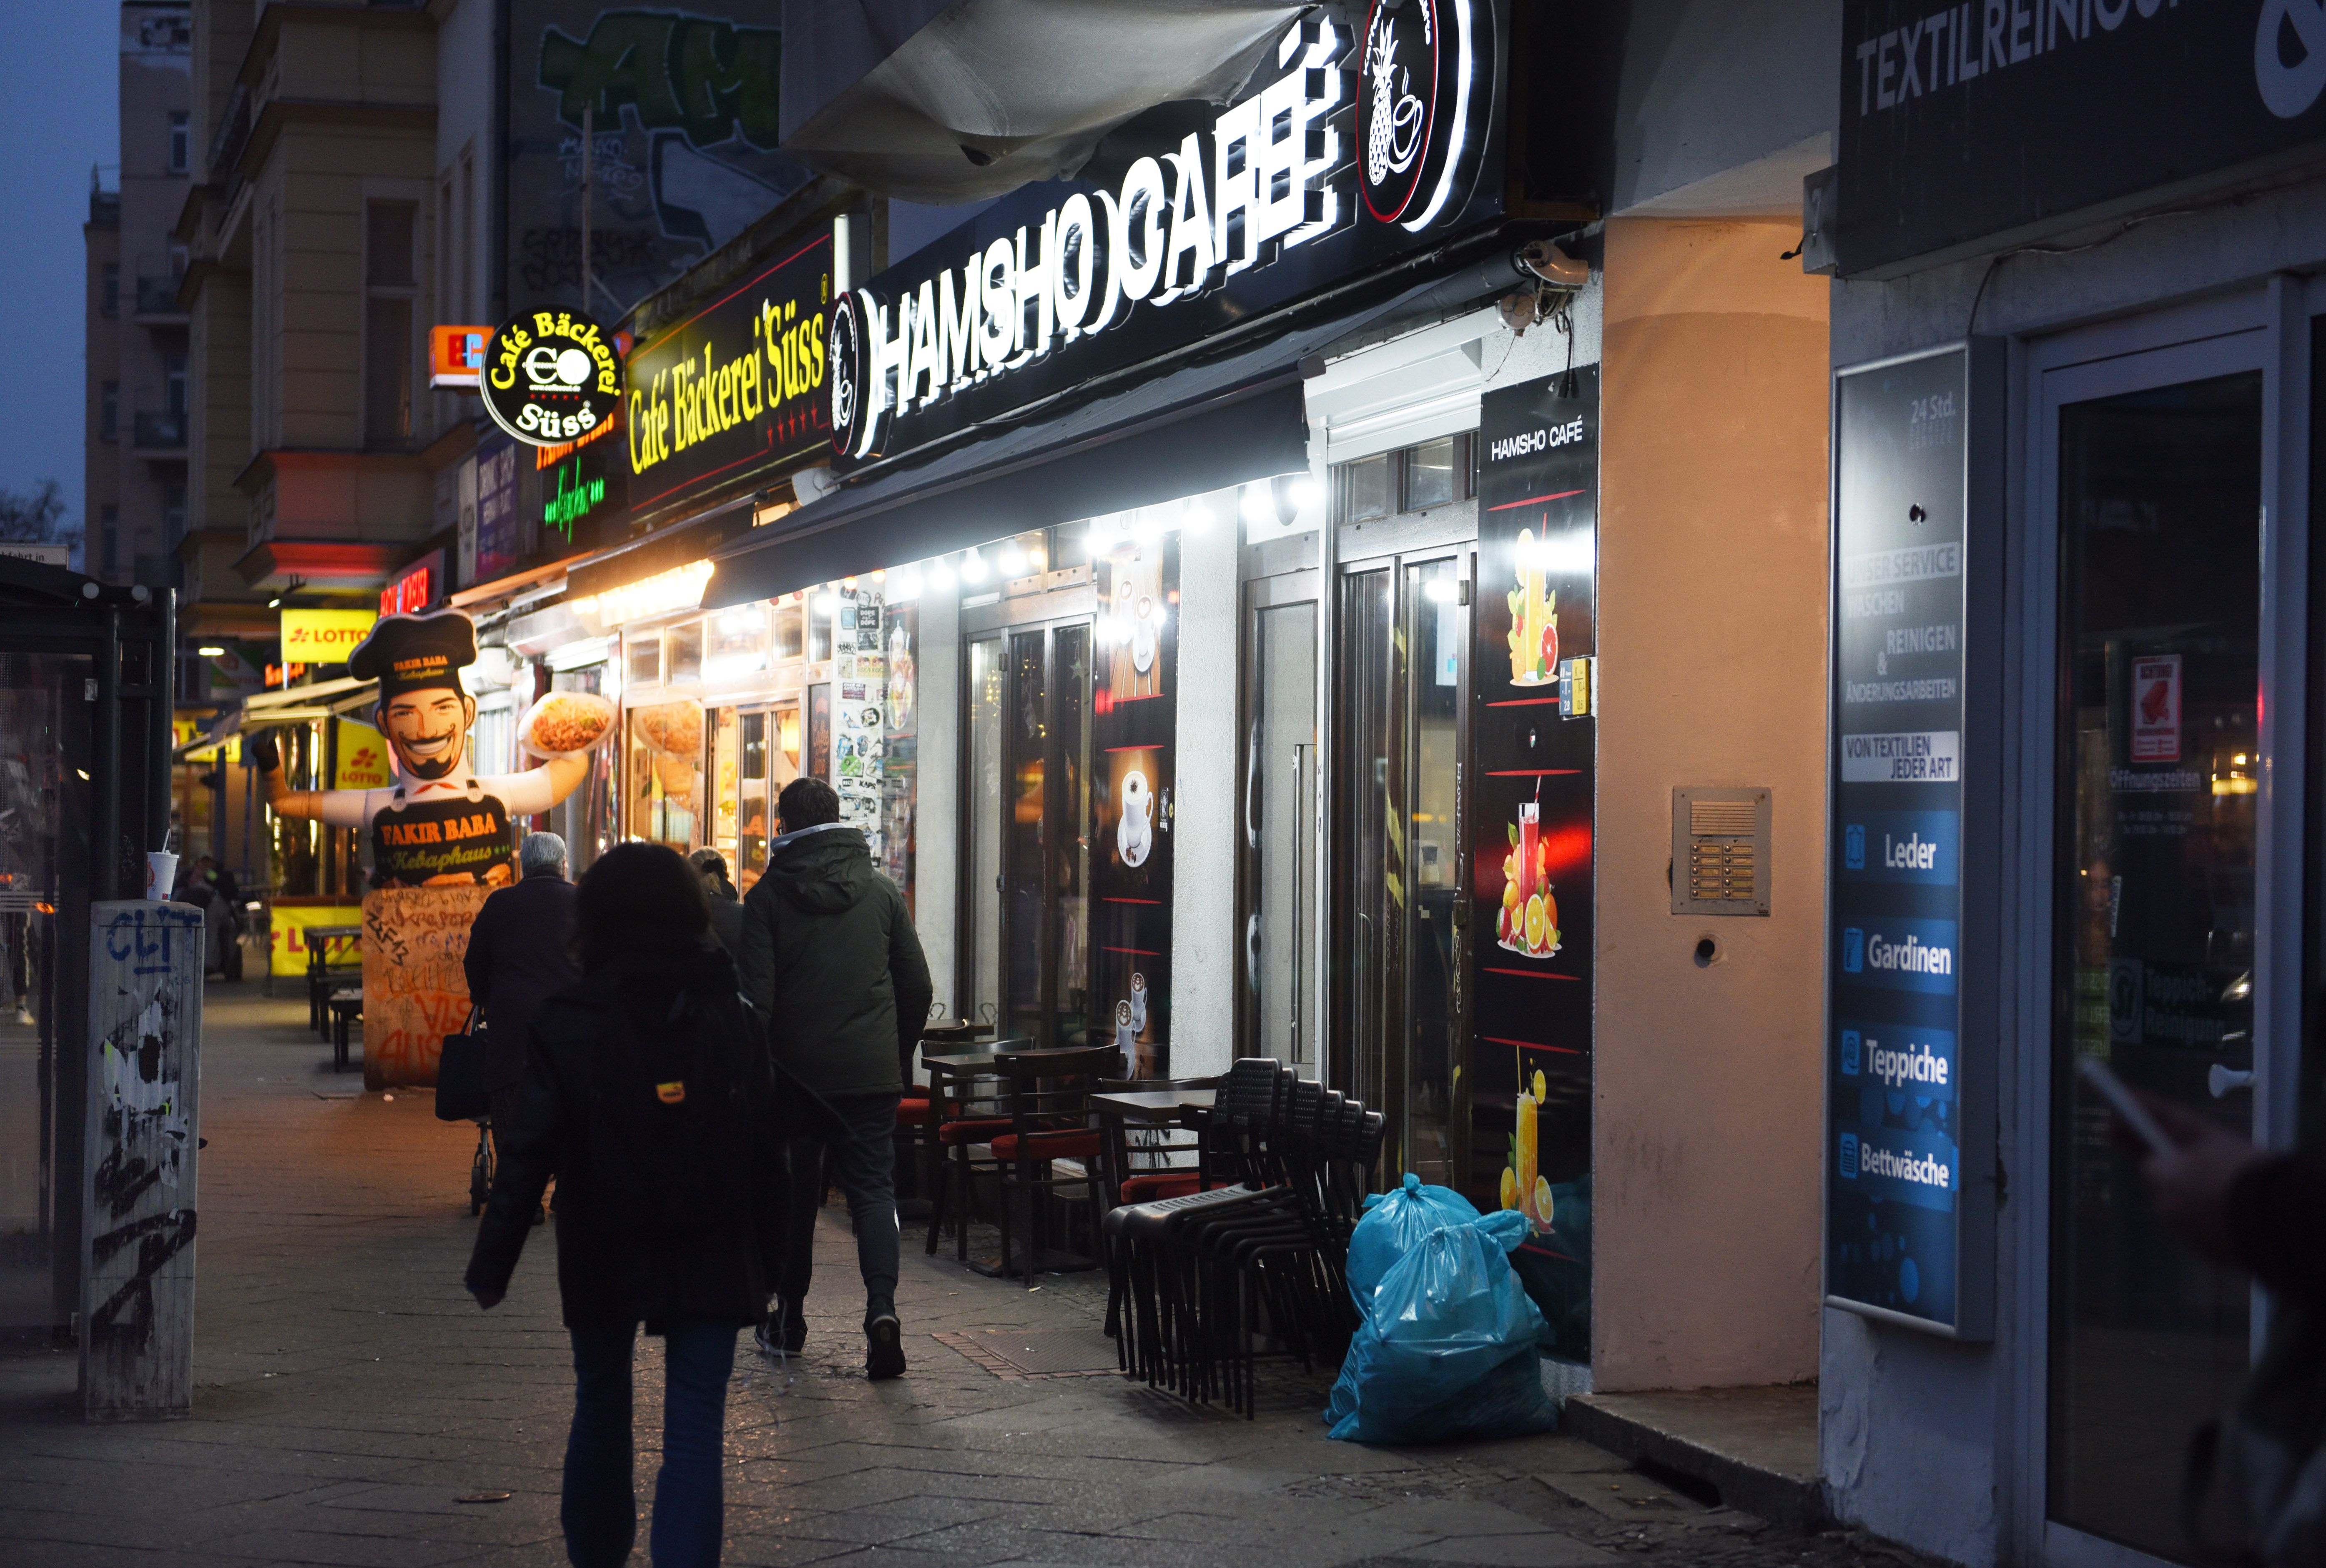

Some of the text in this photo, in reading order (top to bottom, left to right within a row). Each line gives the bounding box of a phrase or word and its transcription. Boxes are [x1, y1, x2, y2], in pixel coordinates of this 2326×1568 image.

[1857, 0, 2177, 116] TEXTILREINI
[878, 16, 1332, 413] HAMSHO CAFÉ
[491, 312, 621, 396] Café Bäckerei
[629, 368, 669, 475] Café
[672, 316, 763, 453] Bäckerei
[766, 299, 825, 408] Süss
[516, 403, 596, 437] Süss
[1491, 415, 1583, 461] HAMSHO CAFÉ
[1894, 546, 1955, 576] SERVICE
[1846, 590, 1904, 617] WASCHEN
[314, 629, 370, 643] LOTTO
[1887, 625, 1955, 654] REINIGEN
[1877, 652, 1887, 675] &
[1845, 678, 1955, 704] ÄNDERUNGSARBEITEN
[1846, 736, 1931, 759] VON TEXTILIEN
[342, 770, 382, 785] LOTTO
[1890, 757, 1952, 779] JEDER ART
[381, 812, 497, 846] FAKIR BABA
[392, 844, 492, 873] Kebaphaus
[1885, 833, 1937, 869] Leder
[1868, 934, 1952, 975] Gardinen
[1866, 1039, 1948, 1087] Teppiche
[1862, 1143, 1949, 1188] Bettwäsche
